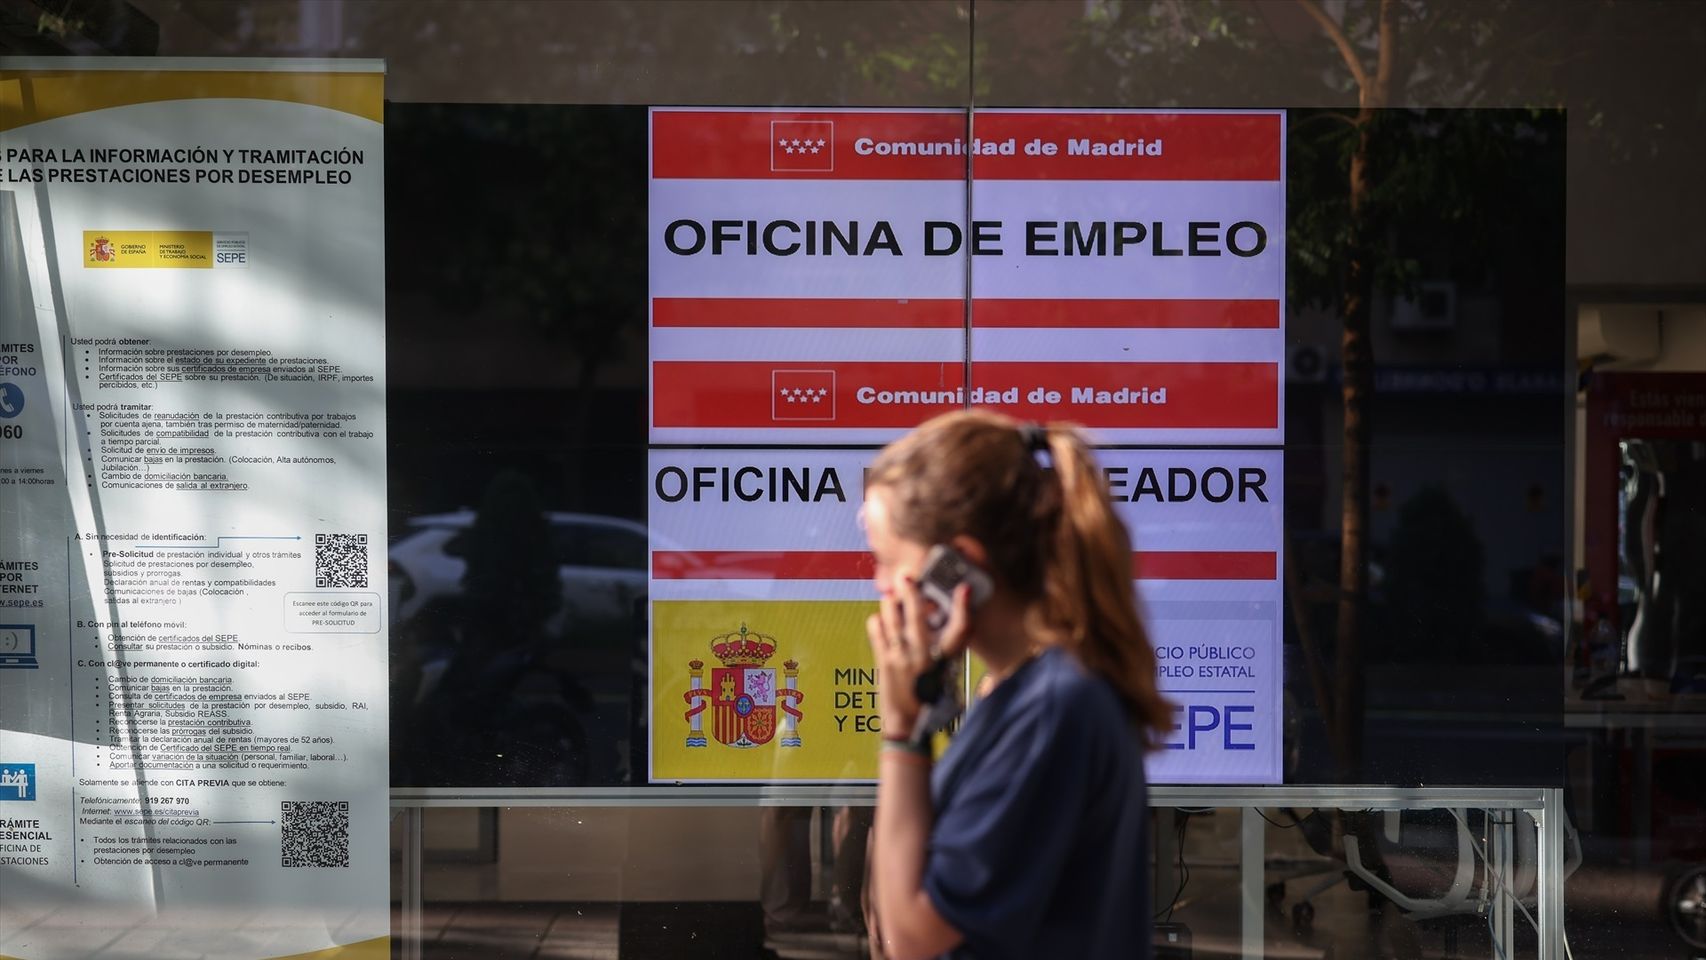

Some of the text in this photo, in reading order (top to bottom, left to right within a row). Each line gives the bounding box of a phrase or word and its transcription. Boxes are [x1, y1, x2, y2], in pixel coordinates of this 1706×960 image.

[854, 138, 1163, 157] Comunidad de Madrid
[7, 148, 58, 163] PARA
[62, 148, 86, 163] LA
[90, 146, 218, 163] INFORMACIÓN
[222, 149, 234, 163] Y
[238, 146, 363, 164] TRAMITACIÓN
[8, 168, 44, 183] LAS
[48, 168, 190, 183] PRESTACIONES
[196, 169, 234, 184] POR
[239, 169, 352, 184] DESEMPLEO
[664, 219, 1267, 257] OFICINA DE EMPLEO
[217, 252, 246, 263] SEPE
[70, 337, 93, 345] Usted
[95, 337, 117, 347] podrá
[1, 344, 34, 353] MITES
[145, 348, 165, 356] sobre
[167, 348, 215, 357] prestaciones
[217, 350, 229, 358] por
[99, 356, 143, 364] Información
[145, 356, 165, 364] sobre
[167, 356, 174, 364] el
[175, 356, 202, 364] estado
[202, 356, 213, 364] de
[226, 356, 266, 366] expediente
[269, 356, 278, 364] de
[99, 364, 143, 372] Información
[145, 364, 165, 372] sobre
[182, 364, 227, 372] certificados
[273, 365, 306, 373] enviados
[308, 365, 315, 373] al
[99, 373, 144, 381] Certificados
[145, 373, 158, 381] del
[160, 373, 182, 381] SEPE
[185, 373, 208, 381] sobre
[342, 374, 374, 383] importes
[856, 386, 1167, 404] Comunidad de Madrid
[72, 403, 95, 411] Usted
[97, 403, 119, 412] podrá
[0, 425, 22, 439] 60
[102, 472, 131, 480] Cambio
[132, 472, 142, 480] de
[144, 472, 191, 480] domiciliación
[102, 481, 163, 489] Comunicaciones
[165, 481, 175, 489] de
[176, 481, 198, 489] salida
[200, 481, 209, 489] al
[655, 466, 846, 503] OFICINA
[1103, 467, 1269, 503] EADOR
[86, 533, 98, 541] Sin
[100, 533, 139, 541] necesidad
[141, 533, 150, 541] de
[102, 550, 154, 558] Pre-Solicitud
[156, 550, 166, 558] de
[208, 550, 243, 558] individual
[0, 584, 38, 594] ERNET
[88, 620, 104, 628] Con
[107, 620, 120, 630] pin
[121, 620, 128, 628] al
[130, 620, 162, 628] teléfono
[1189, 644, 1255, 660] PÚBLICO
[88, 659, 105, 667] Con
[107, 659, 132, 668] cl@ve
[134, 660, 179, 669] permanente
[188, 659, 231, 667] certificado
[1156, 666, 1255, 678] PLEO ESTATAL
[835, 692, 863, 709] DE
[834, 716, 848, 732] Y
[145, 797, 159, 805] 919
[161, 797, 174, 805] 267
[176, 797, 189, 805] 970
[0, 818, 40, 828] RÁMITE
[0, 831, 52, 840] ESENCIAL
[93, 836, 117, 844] Todos
[118, 836, 130, 844] los
[131, 836, 161, 844] trámites
[162, 836, 208, 844] relacionados
[0, 844, 41, 853] FICINA DE
[94, 846, 196, 856] prestaciones por desempleo
[1, 857, 49, 865] STACIONES
